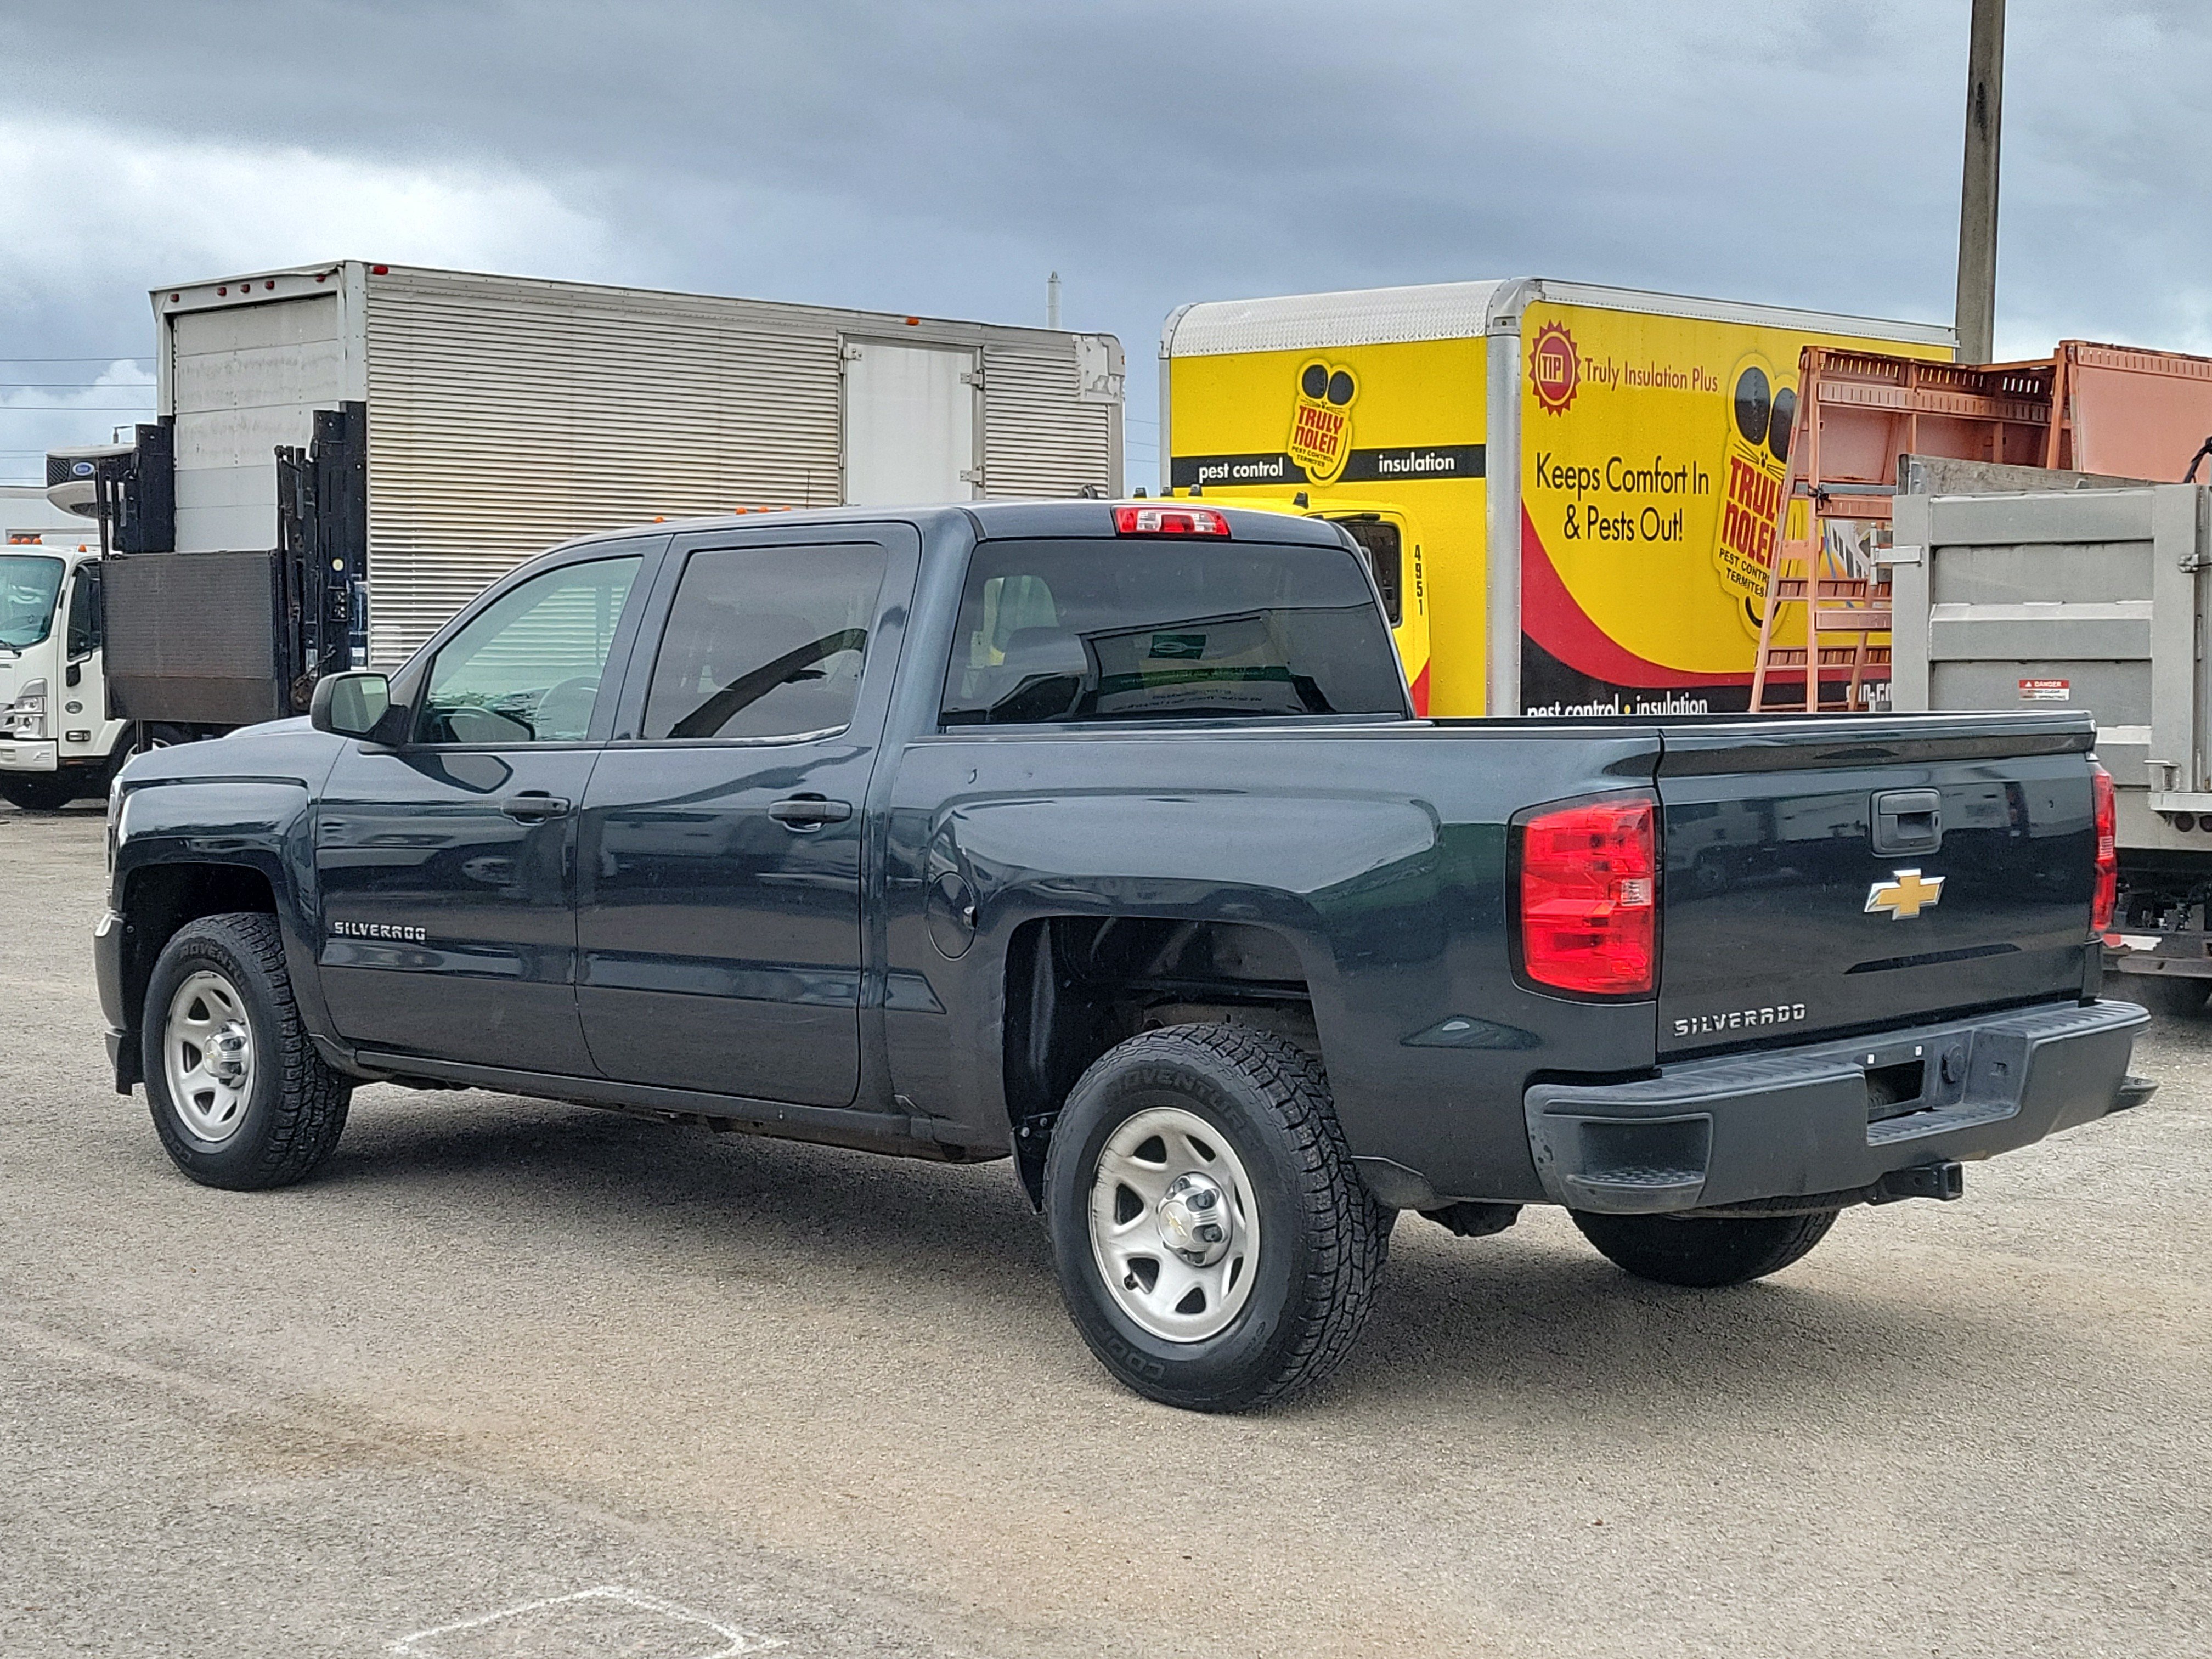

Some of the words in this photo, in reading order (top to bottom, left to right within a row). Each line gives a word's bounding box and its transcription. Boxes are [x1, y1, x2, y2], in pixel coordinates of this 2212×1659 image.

[1542, 356, 1561, 381] TIP
[1585, 357, 1620, 392] Truly
[1624, 360, 1688, 390] Insulation
[1692, 366, 1718, 393] Plus
[1298, 405, 1344, 436] TRULY
[1293, 425, 1339, 456] NOLEN
[1198, 462, 1229, 484] pest
[1233, 456, 1284, 477] control
[1378, 451, 1455, 473] insulation
[1536, 452, 1601, 502] Keeps
[1606, 455, 1688, 494] Comfort
[1693, 460, 1709, 495] In
[1564, 504, 1581, 540] &
[1587, 505, 1635, 541] Pests
[1640, 507, 1683, 542] Out!
[1414, 544, 1423, 616] 4951
[1719, 548, 1740, 567] PEST
[1741, 560, 1770, 584] CONTR
[1726, 567, 1765, 598] TERMITES
[1635, 690, 1708, 715] insulation
[334, 922, 426, 941] SILVERADO
[1673, 1003, 1805, 1037] SILVERADO
